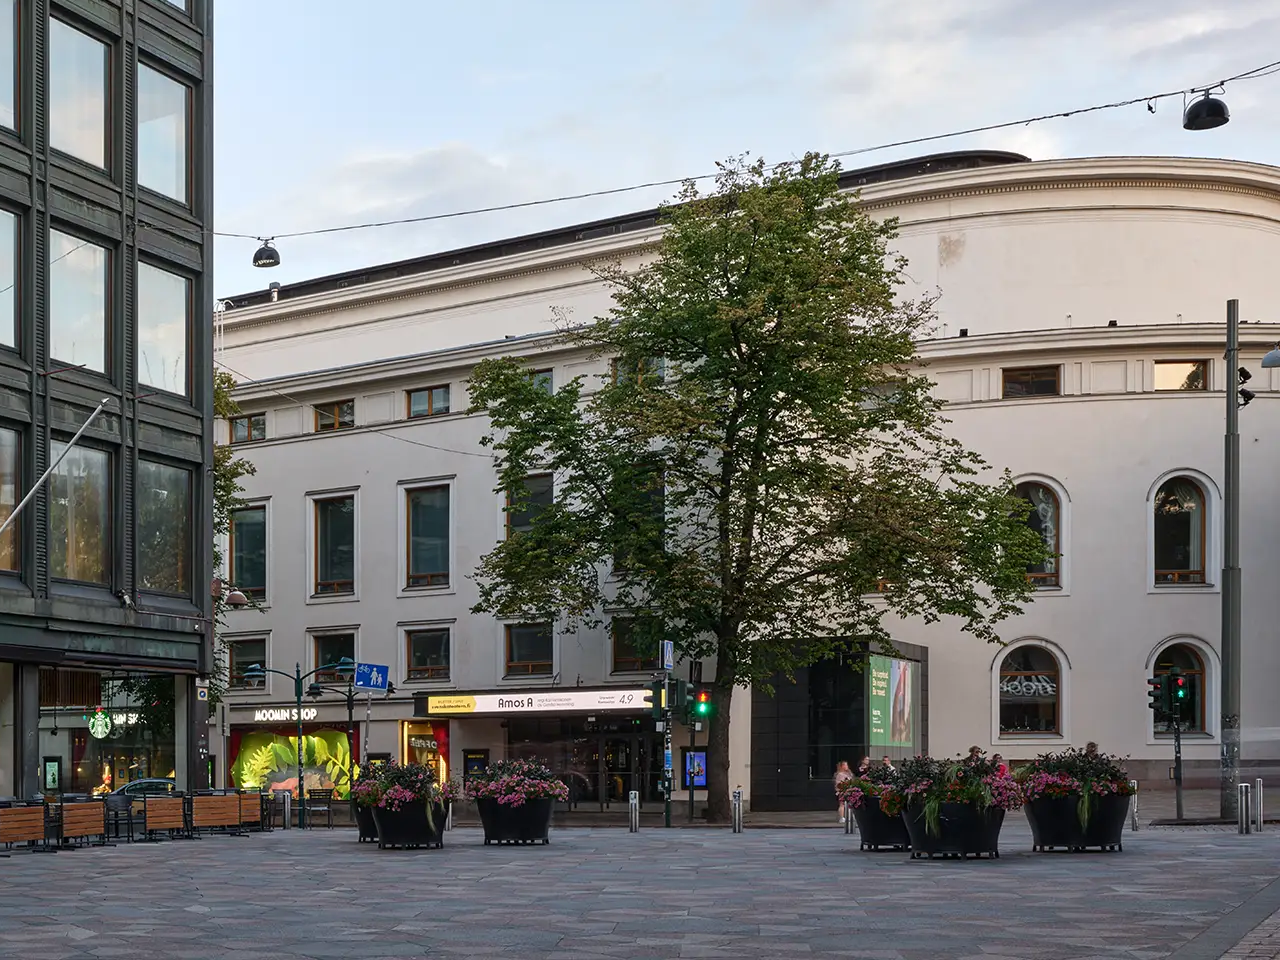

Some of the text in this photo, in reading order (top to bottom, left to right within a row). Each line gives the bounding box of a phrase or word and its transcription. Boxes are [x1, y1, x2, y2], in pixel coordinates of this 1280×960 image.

[498, 697, 533, 708] Amos A
[619, 694, 633, 704] 4.9
[255, 709, 290, 721] MOOMIN
